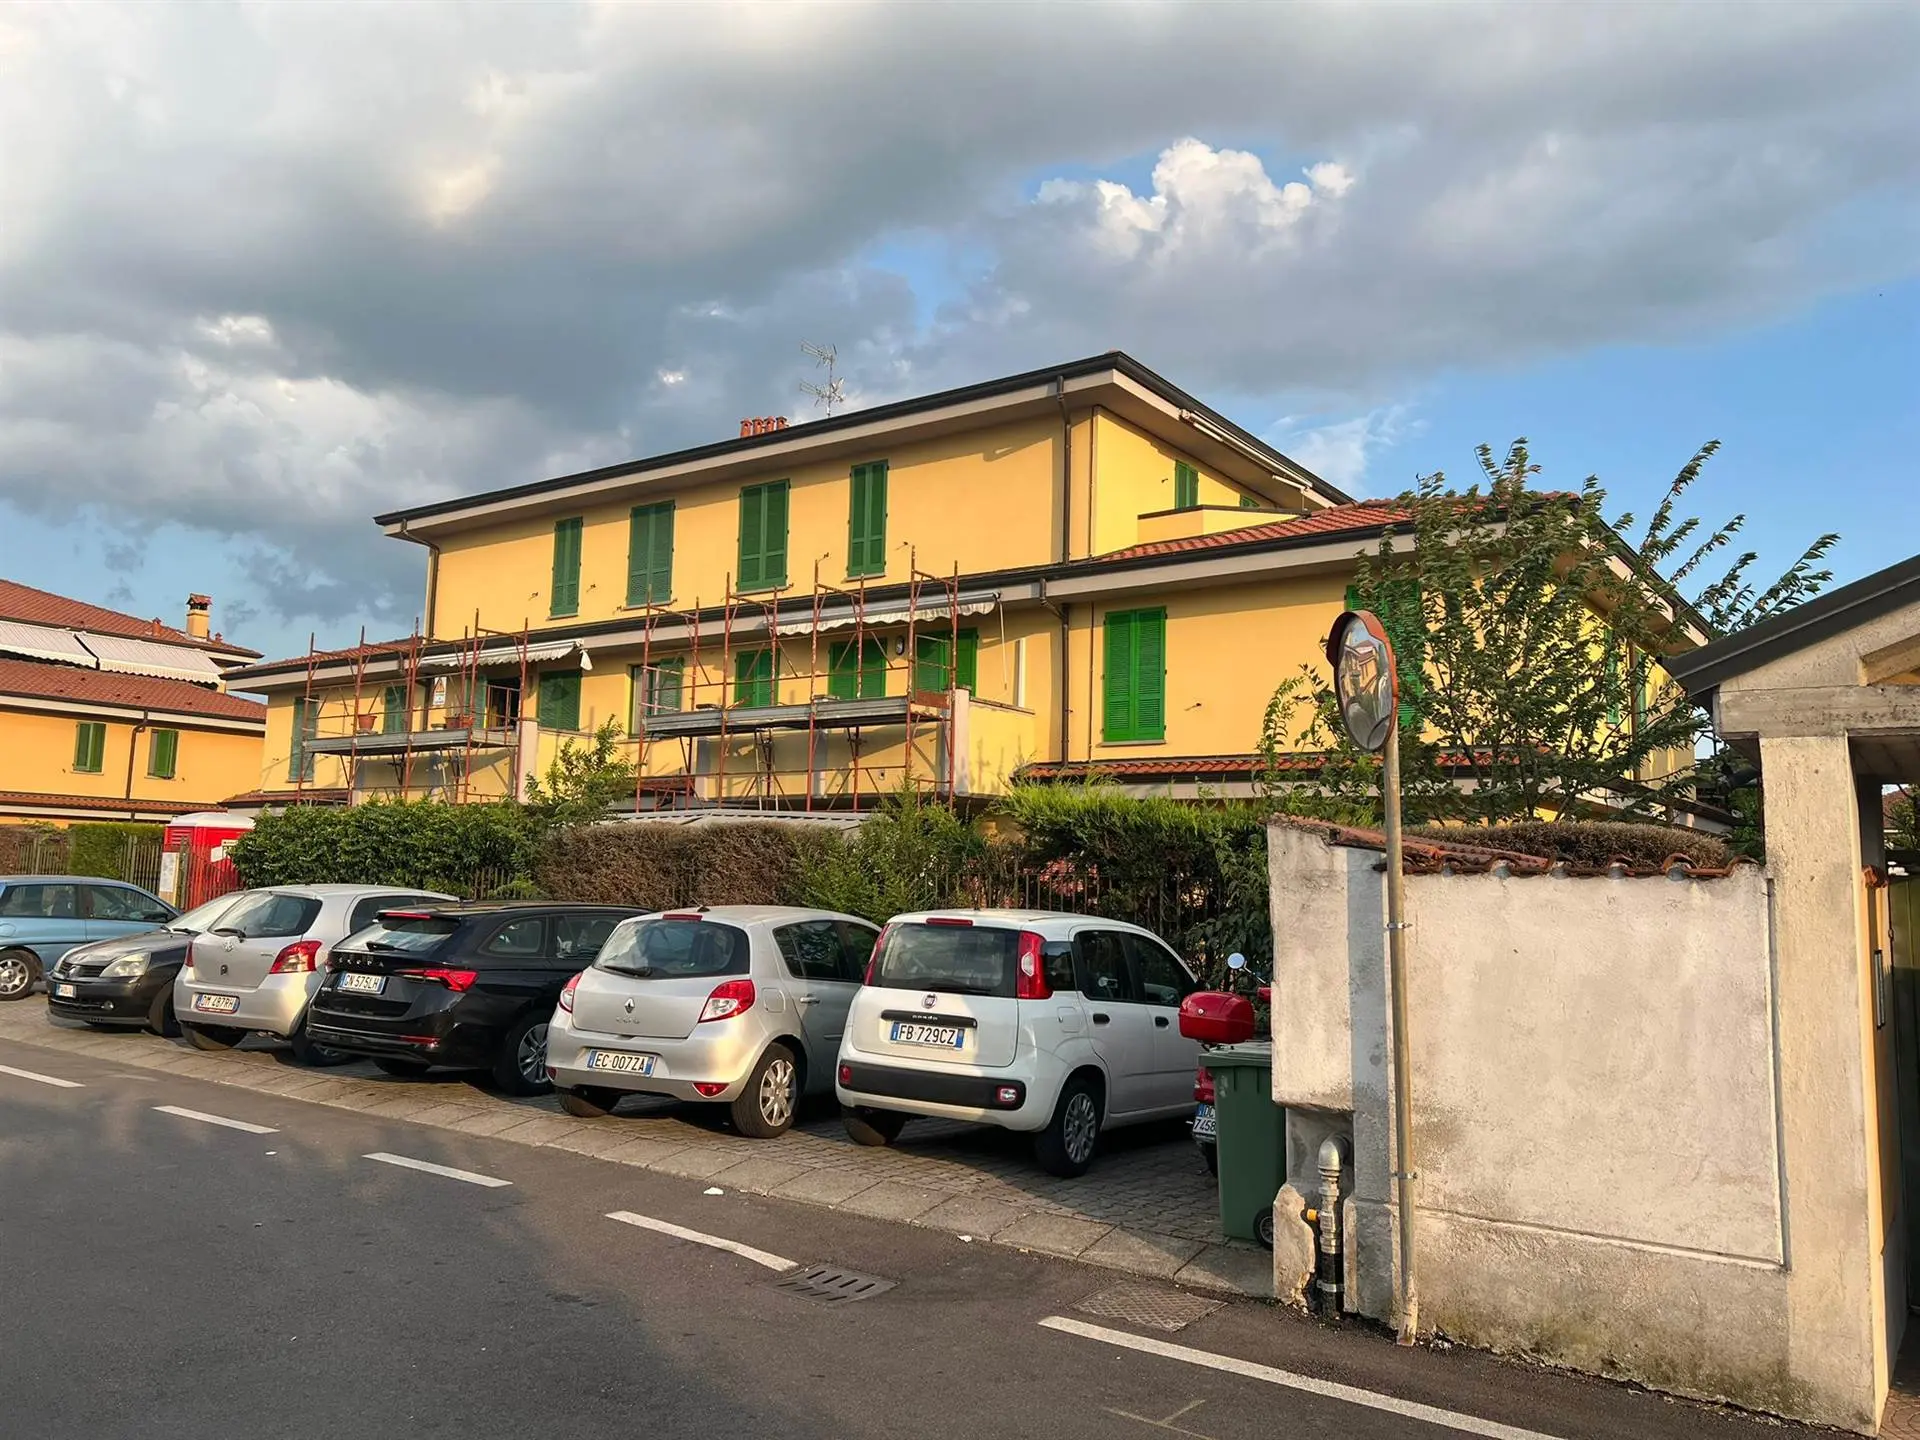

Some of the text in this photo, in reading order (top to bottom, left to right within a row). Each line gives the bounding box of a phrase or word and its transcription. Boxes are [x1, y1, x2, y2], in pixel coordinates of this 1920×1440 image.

[898, 1024, 956, 1045] FB 729CZ
[594, 1053, 646, 1072] EC 007ZA
